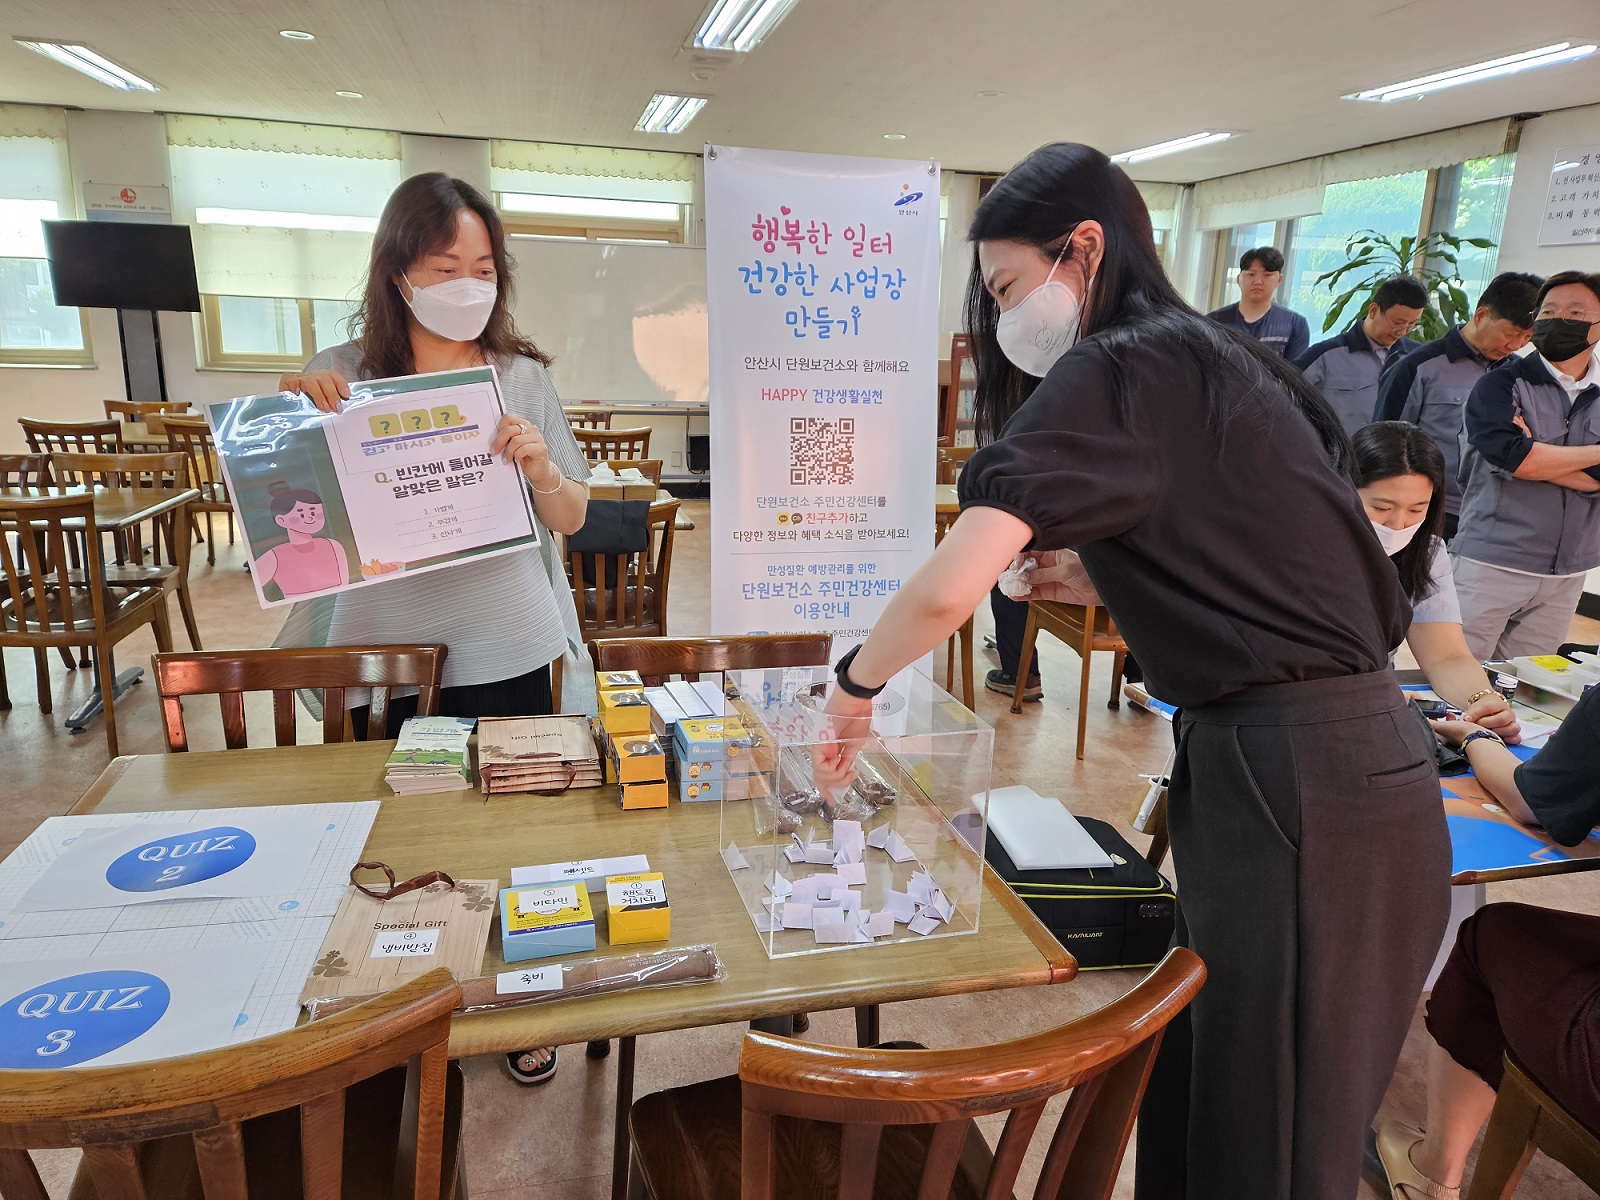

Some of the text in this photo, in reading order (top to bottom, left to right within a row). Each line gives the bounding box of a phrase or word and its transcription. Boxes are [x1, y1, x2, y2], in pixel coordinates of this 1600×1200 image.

[751, 212, 892, 258] 행복한 일터
[737, 259, 907, 301] 건강한 사업장
[785, 304, 862, 339] 만들기
[744, 356, 910, 374] 안산시 단원보건소와 함께해요
[761, 387, 883, 405] HAPPY 건강생활실천
[374, 452, 494, 484] Q. 빈칸에 들어갈
[392, 470, 485, 499] 알맞은 말은?
[756, 495, 887, 509] 단원보건소 주민건강센터를
[806, 512, 868, 525] 친구추가하고
[733, 528, 910, 542] 다양한 정보와 혜택 소식을 받아보세요!
[767, 562, 876, 577] 만성질환 예방관리를 위한
[742, 579, 901, 600] 단원보건소 주민건강센터
[793, 601, 850, 620] 이용안내
[137, 835, 241, 863] QUIZ
[155, 865, 187, 883] 2
[373, 920, 448, 931] Special Gift
[520, 972, 544, 985] 죽비
[17, 985, 152, 1019] QUIZ
[36, 1028, 77, 1058] 3
